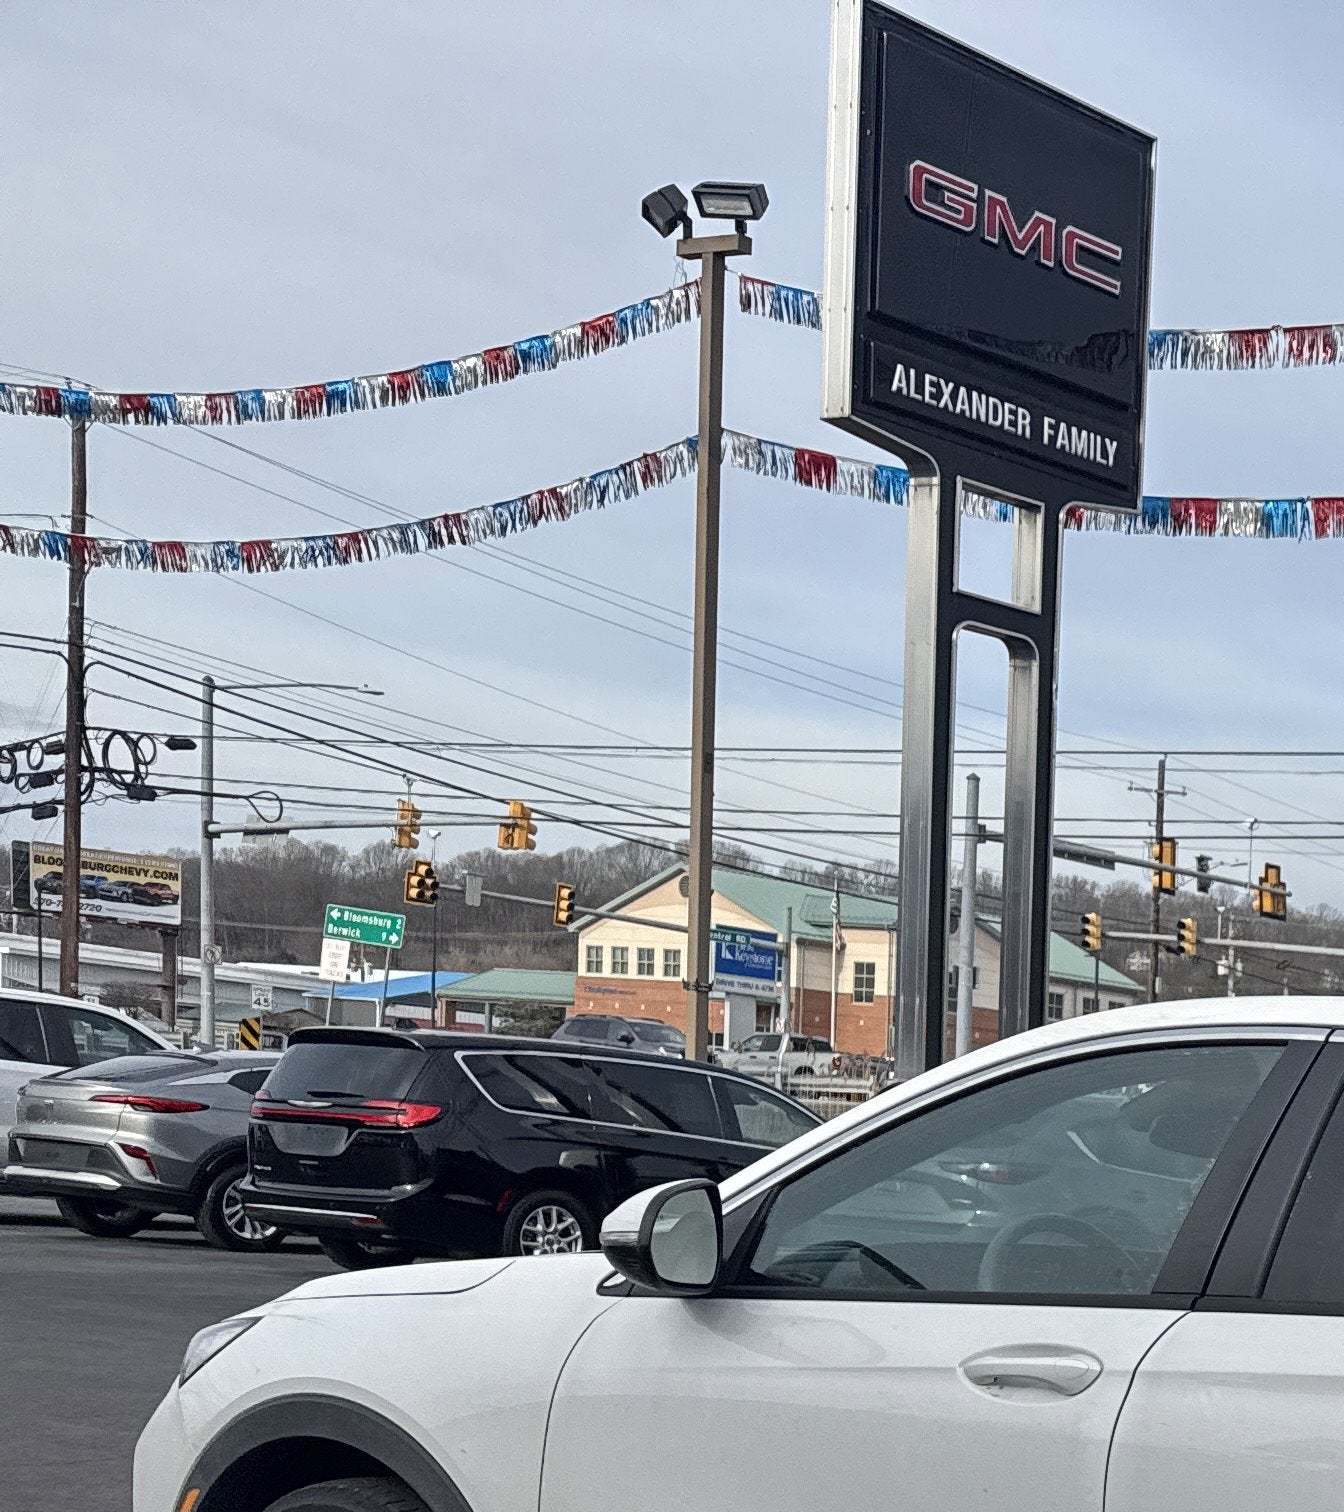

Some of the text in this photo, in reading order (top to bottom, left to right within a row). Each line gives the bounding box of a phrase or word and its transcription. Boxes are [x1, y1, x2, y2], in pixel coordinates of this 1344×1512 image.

[909, 160, 1122, 295] GMC
[891, 363, 1118, 467] ALEXANDER FAMILY
[33, 854, 179, 882] BLOOBURGCHEVY.COM
[343, 911, 402, 930] Bloomsburg 2
[327, 923, 387, 942] Berwick 9
[253, 998, 271, 1008] 45
